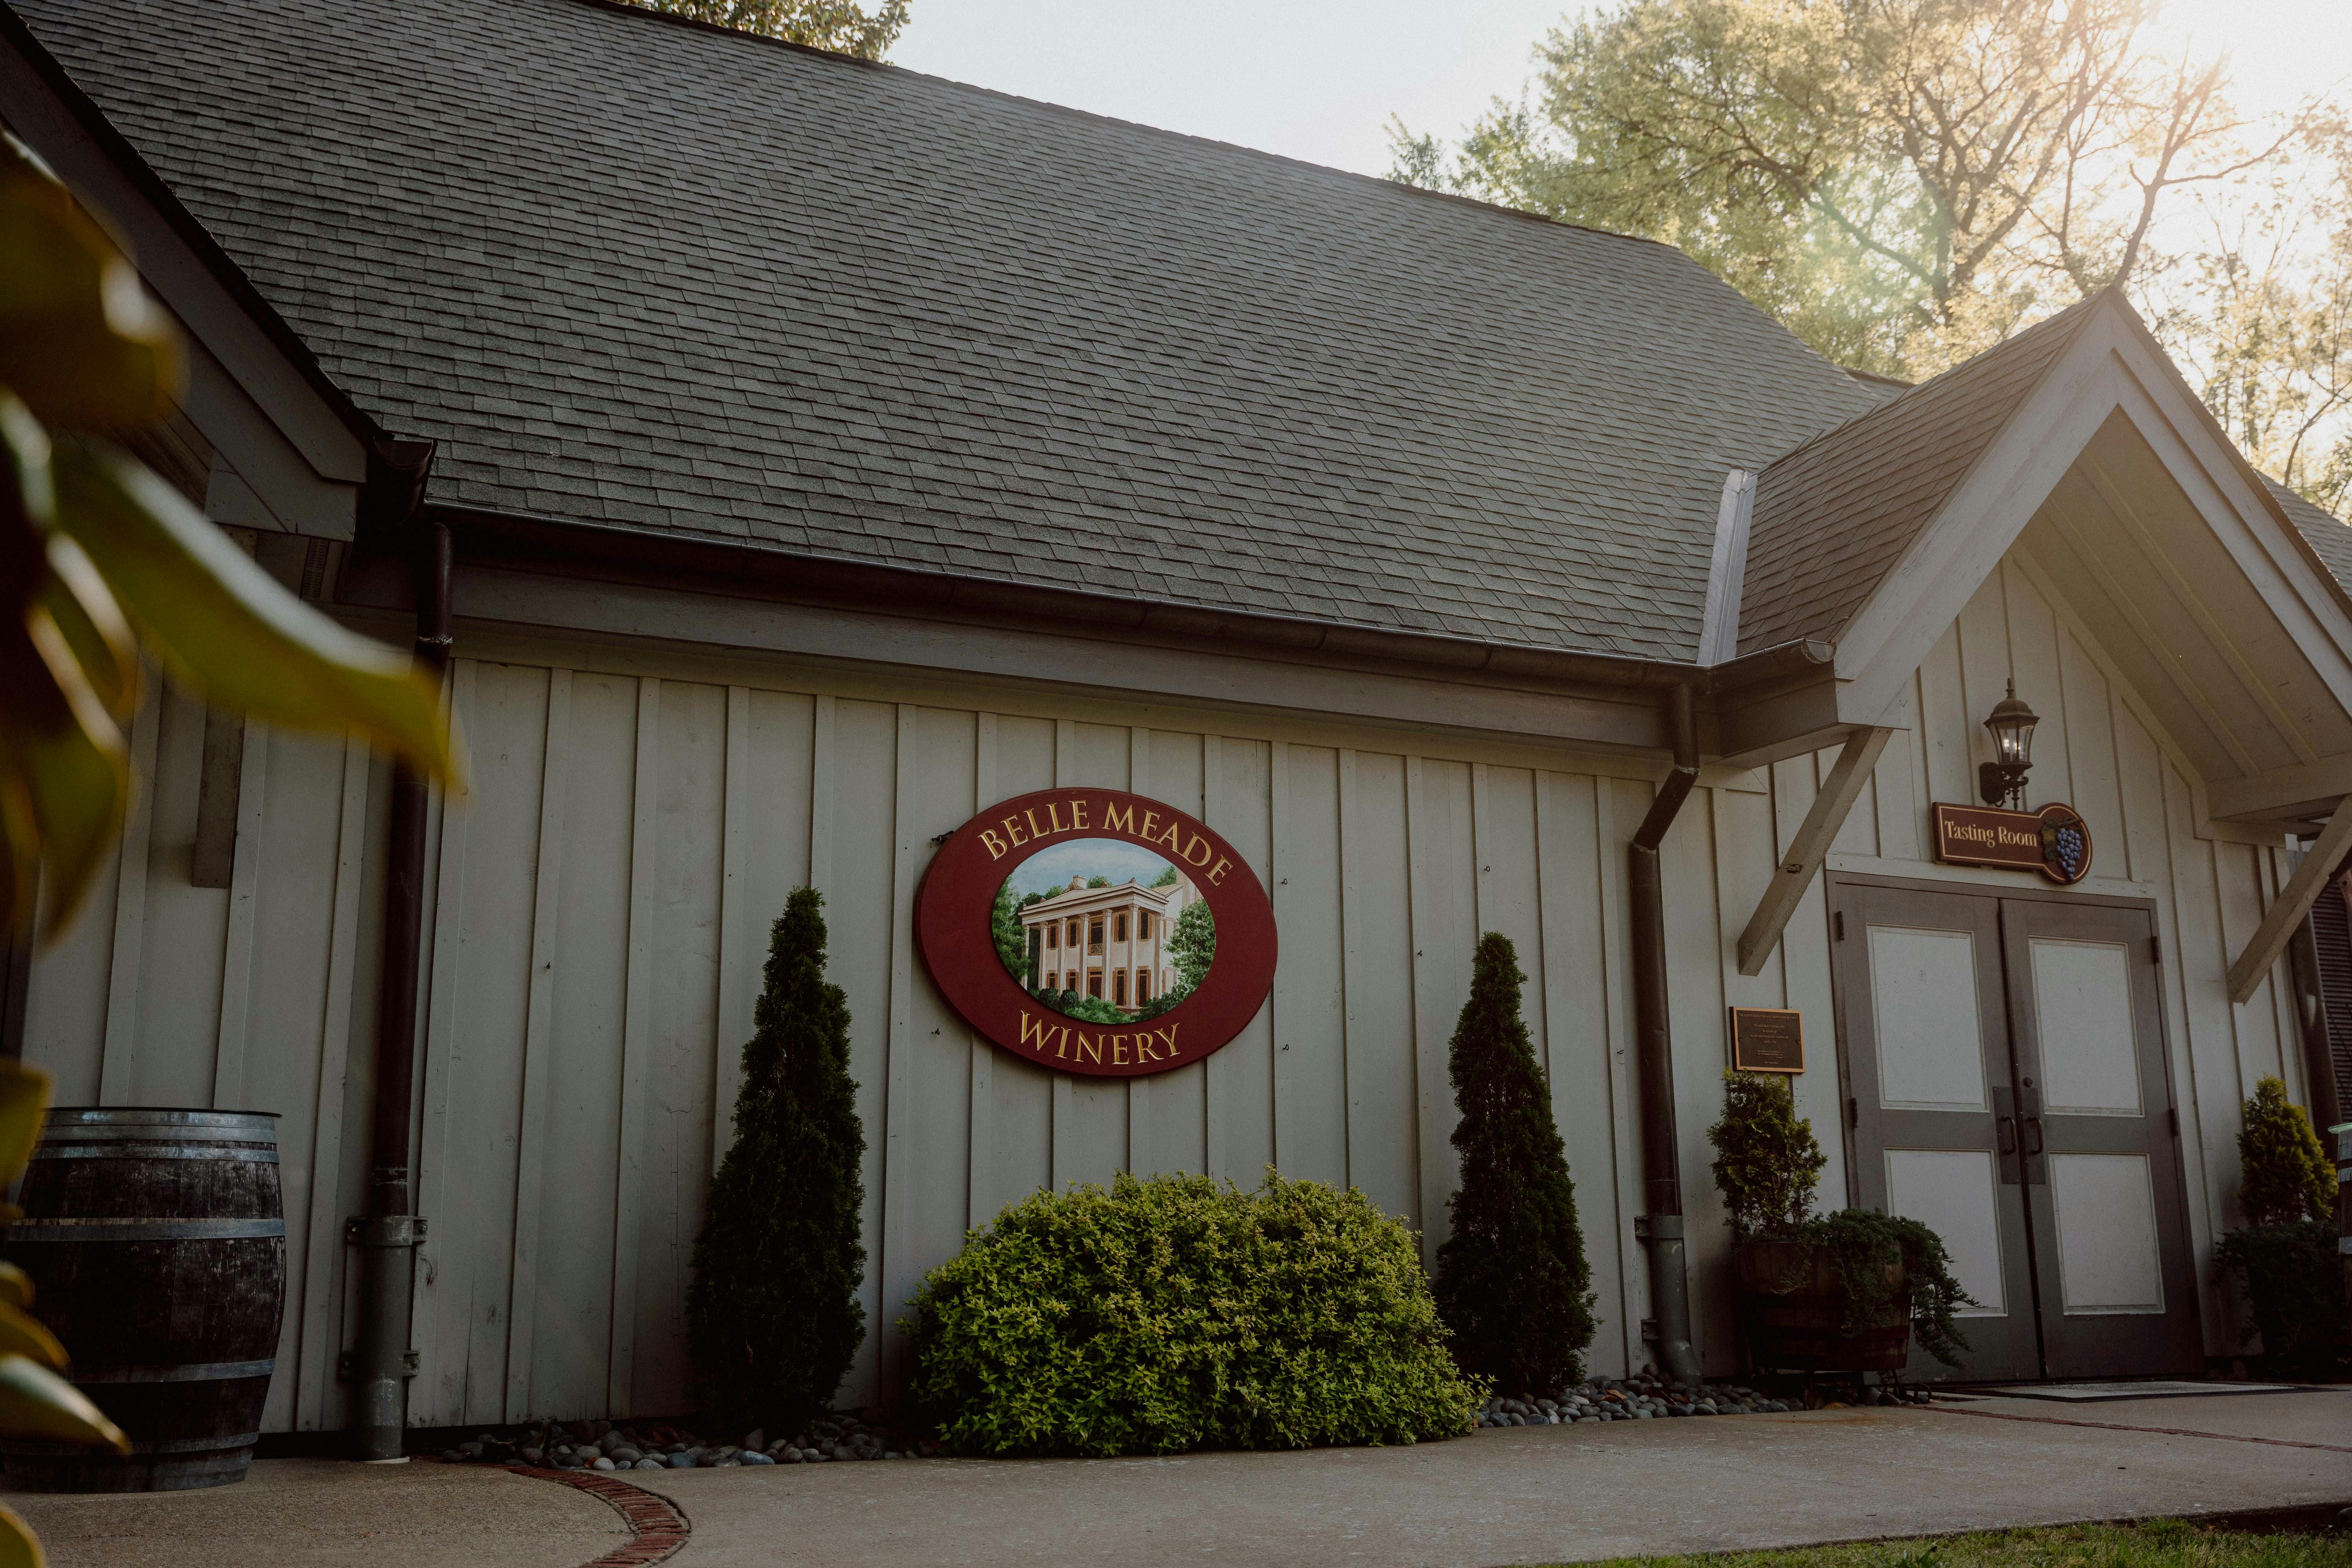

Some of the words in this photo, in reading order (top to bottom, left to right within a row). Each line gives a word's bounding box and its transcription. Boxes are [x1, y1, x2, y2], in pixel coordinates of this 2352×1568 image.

[978, 800, 1090, 861] BELLE
[1102, 801, 1233, 886] MEADE
[1944, 820, 1995, 848] Tasting
[1998, 826, 2038, 847] Room
[1020, 1010, 1181, 1065] WINERY
